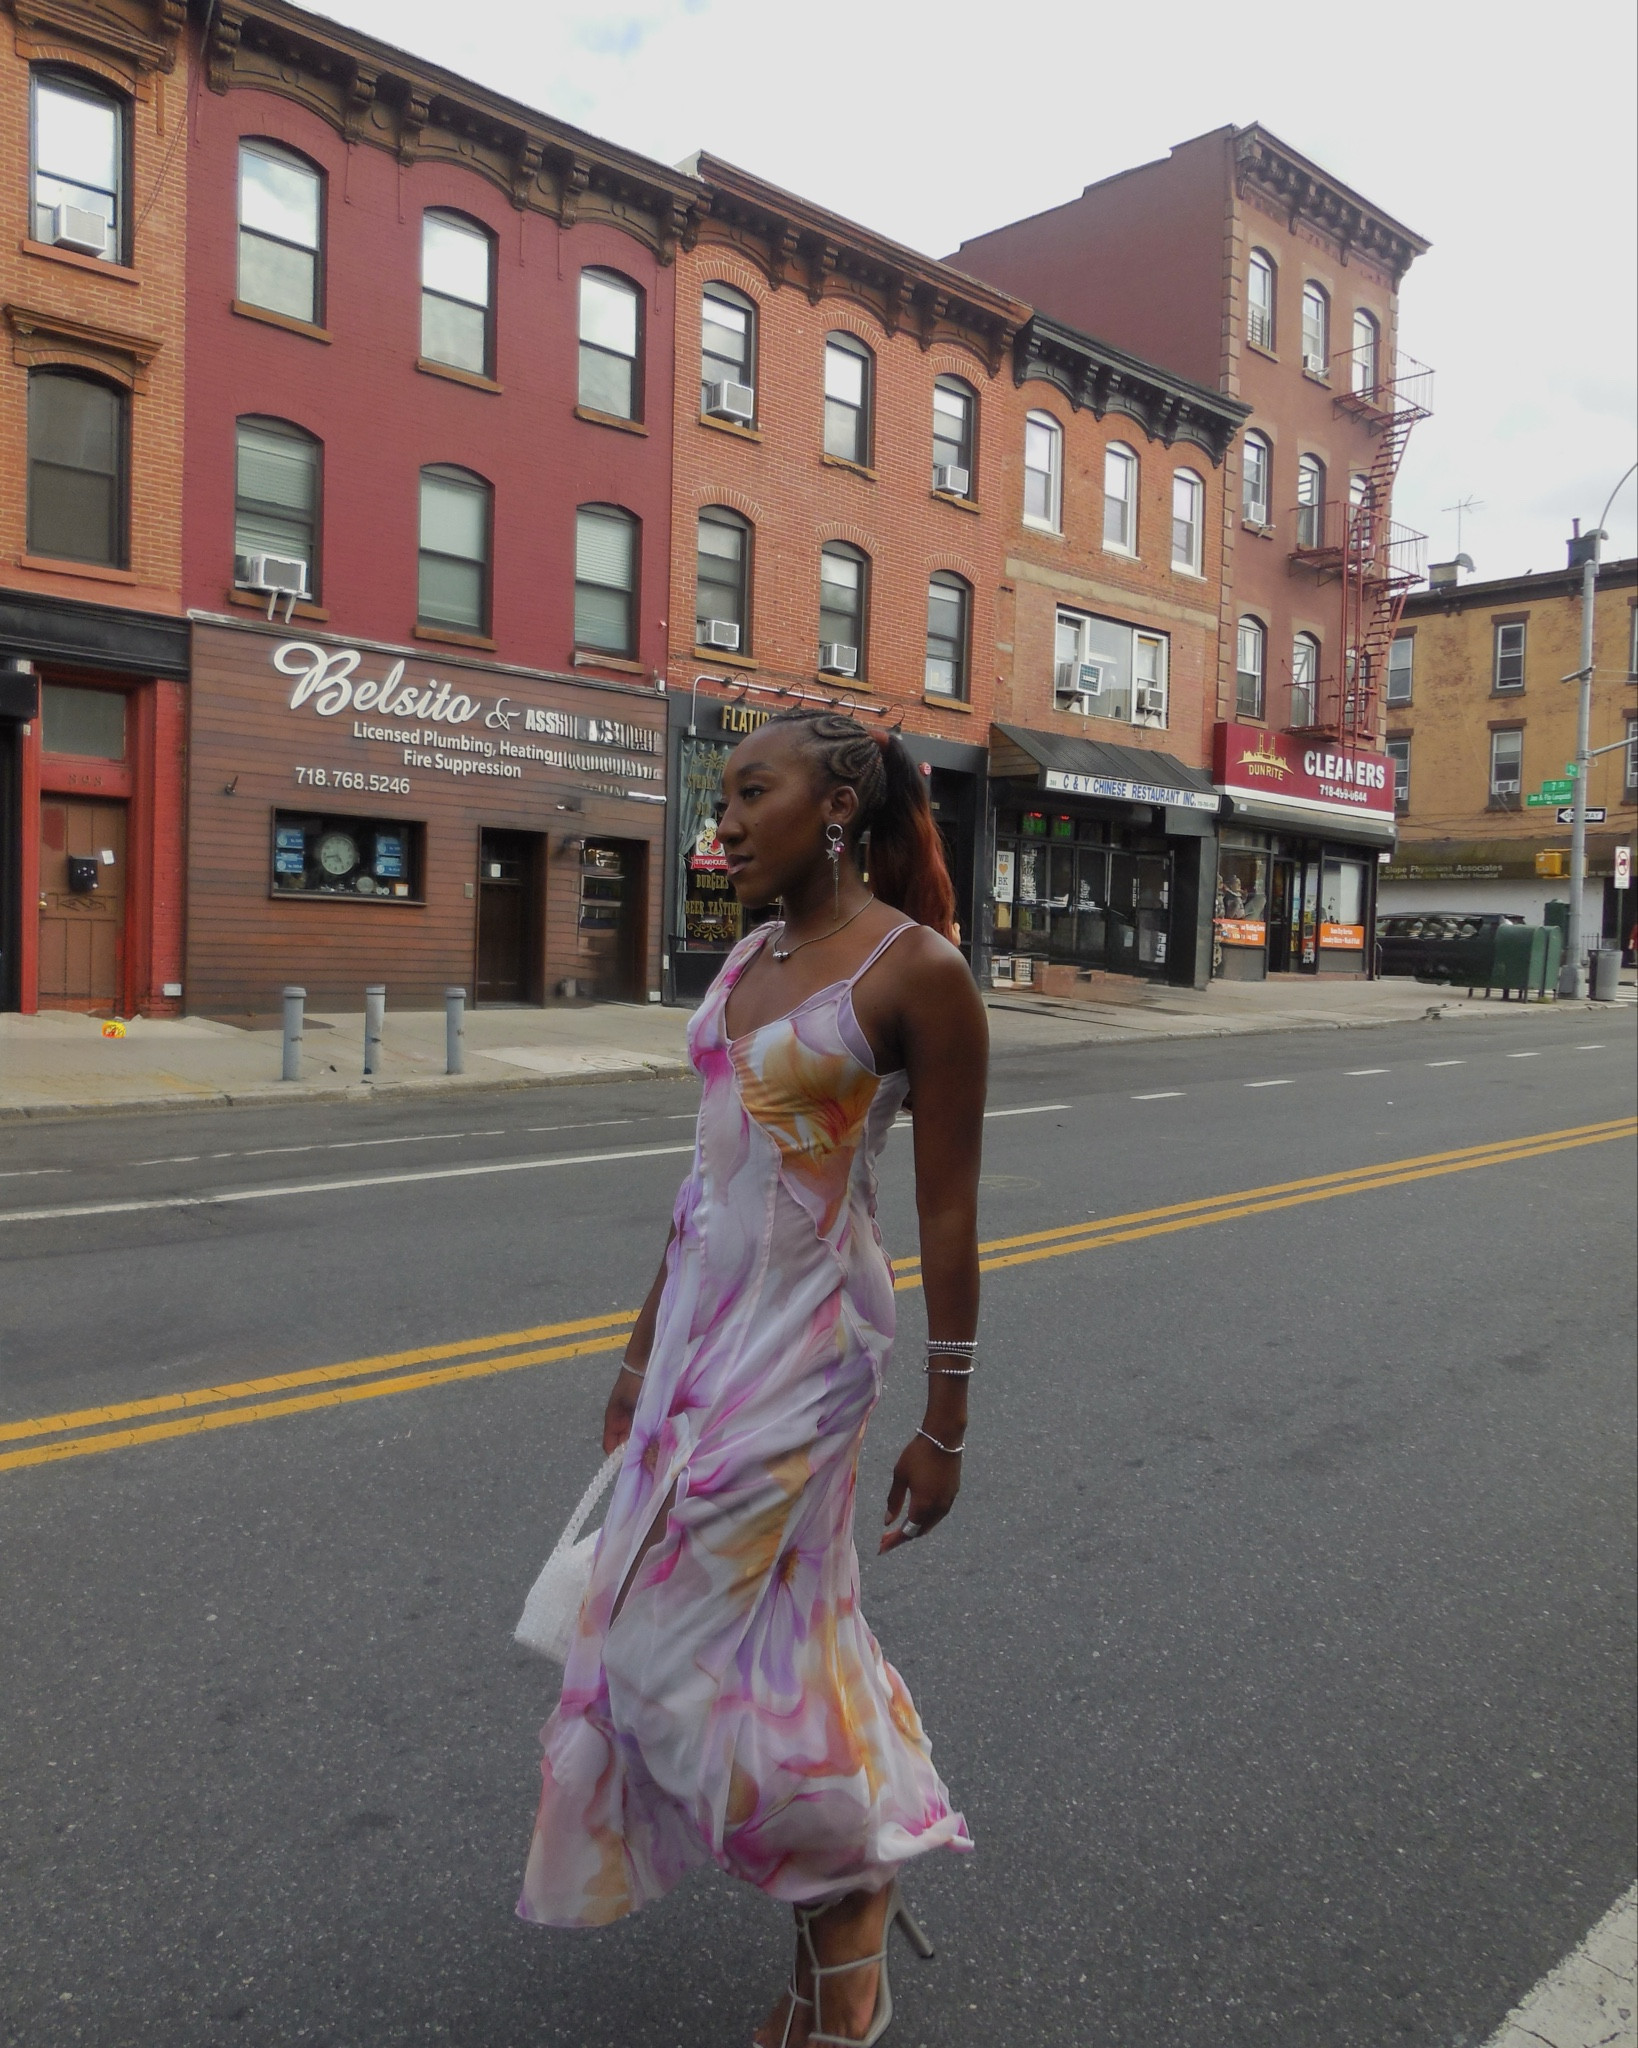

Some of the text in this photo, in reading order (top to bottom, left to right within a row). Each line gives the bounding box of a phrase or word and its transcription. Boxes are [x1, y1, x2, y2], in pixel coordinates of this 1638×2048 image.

[274, 642, 520, 730] Belsito &
[353, 721, 420, 745] Licensed
[424, 730, 496, 756] Plumbing,
[404, 750, 521, 778] Fire Suppression
[1248, 750, 1385, 789] DUNRITE CLEANERS
[296, 766, 411, 794] 718.768.5246
[1063, 774, 1069, 789] C
[1073, 776, 1079, 791] &
[1083, 778, 1090, 792] Y
[1093, 780, 1127, 797] CHINESE
[1132, 785, 1181, 804] RESTAURANT
[1183, 792, 1197, 807] INC.
[695, 858, 728, 866] STEAKHOUSE
[998, 854, 1009, 862] WE
[1456, 864, 1503, 872] Associates
[696, 873, 729, 890] BURGERS
[685, 898, 741, 917] BEER TASTING
